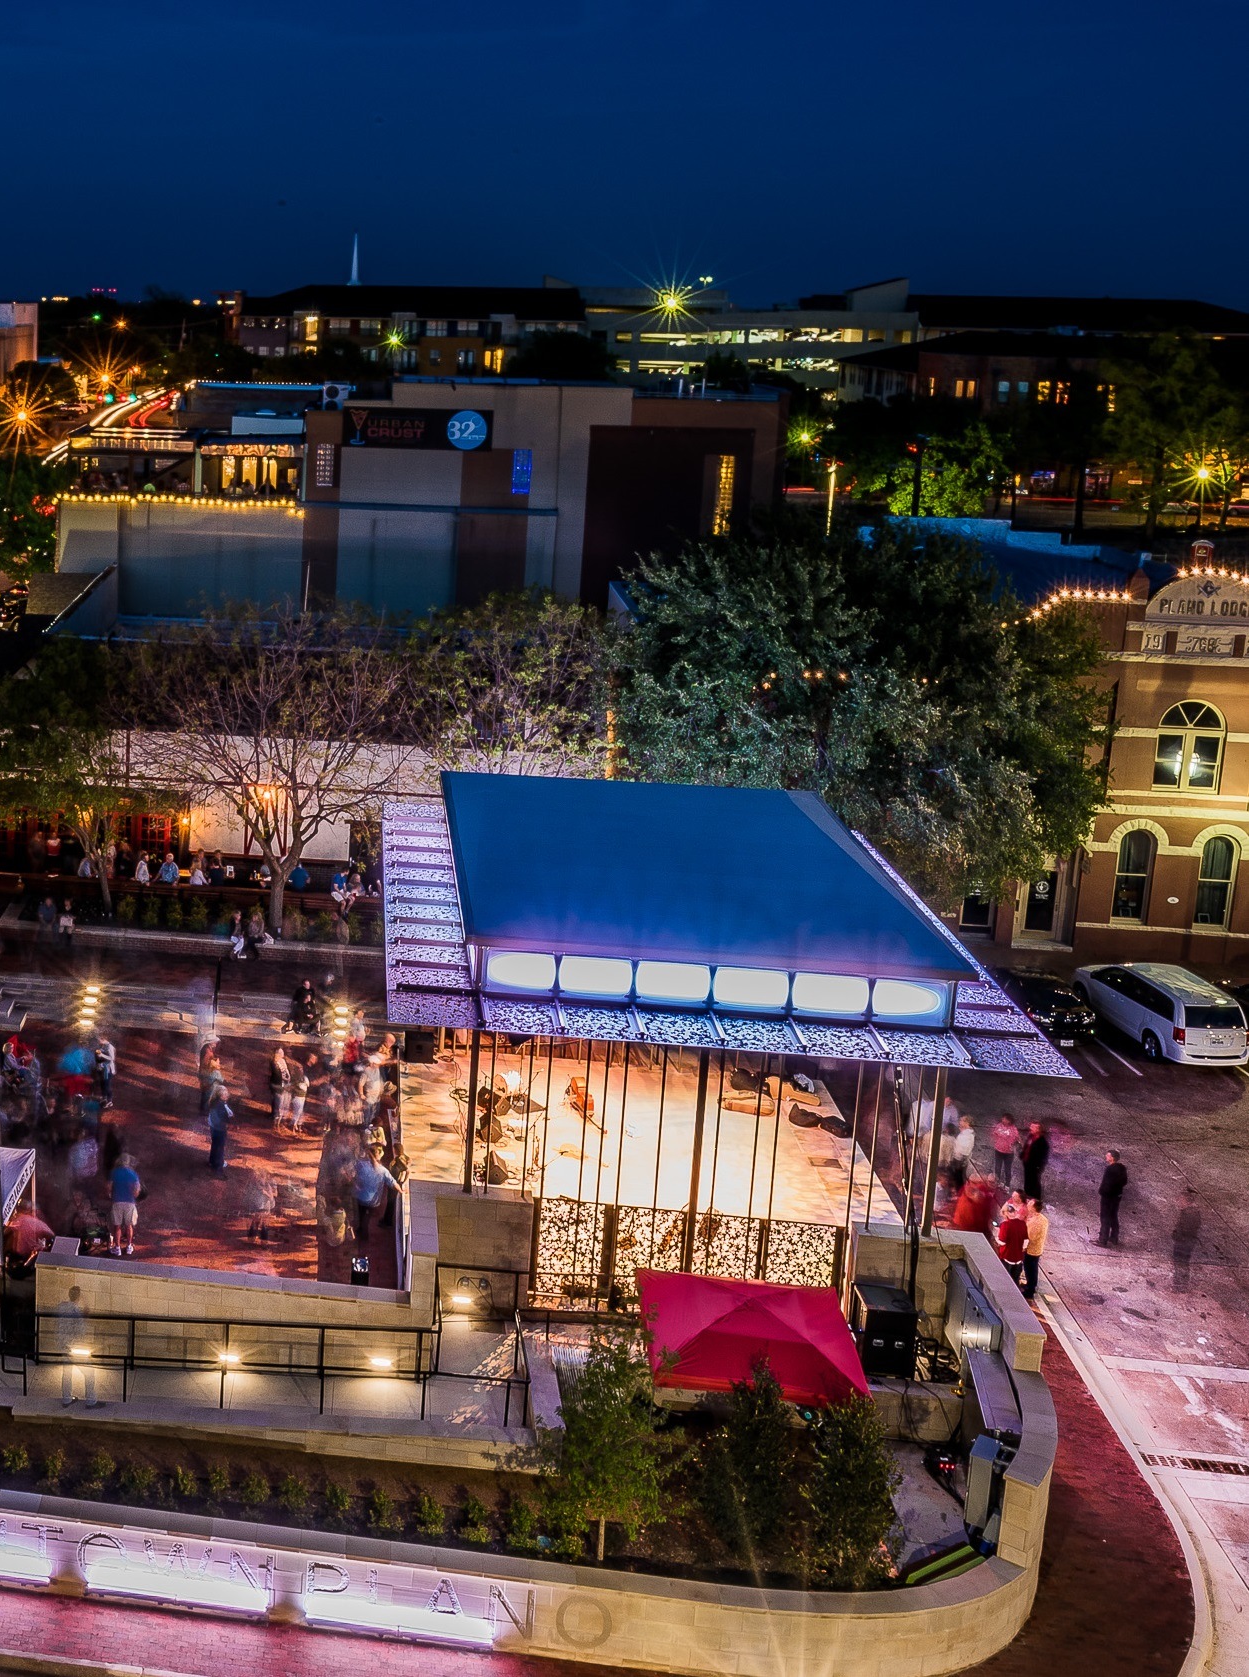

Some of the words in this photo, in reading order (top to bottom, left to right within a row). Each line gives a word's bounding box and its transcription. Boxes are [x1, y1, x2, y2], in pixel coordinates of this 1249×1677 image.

[367, 418, 425, 429] URBAN
[447, 420, 476, 440] 32
[367, 427, 425, 439] CRUST
[1158, 597, 1205, 615] PLANO
[1210, 600, 1249, 618] LODG
